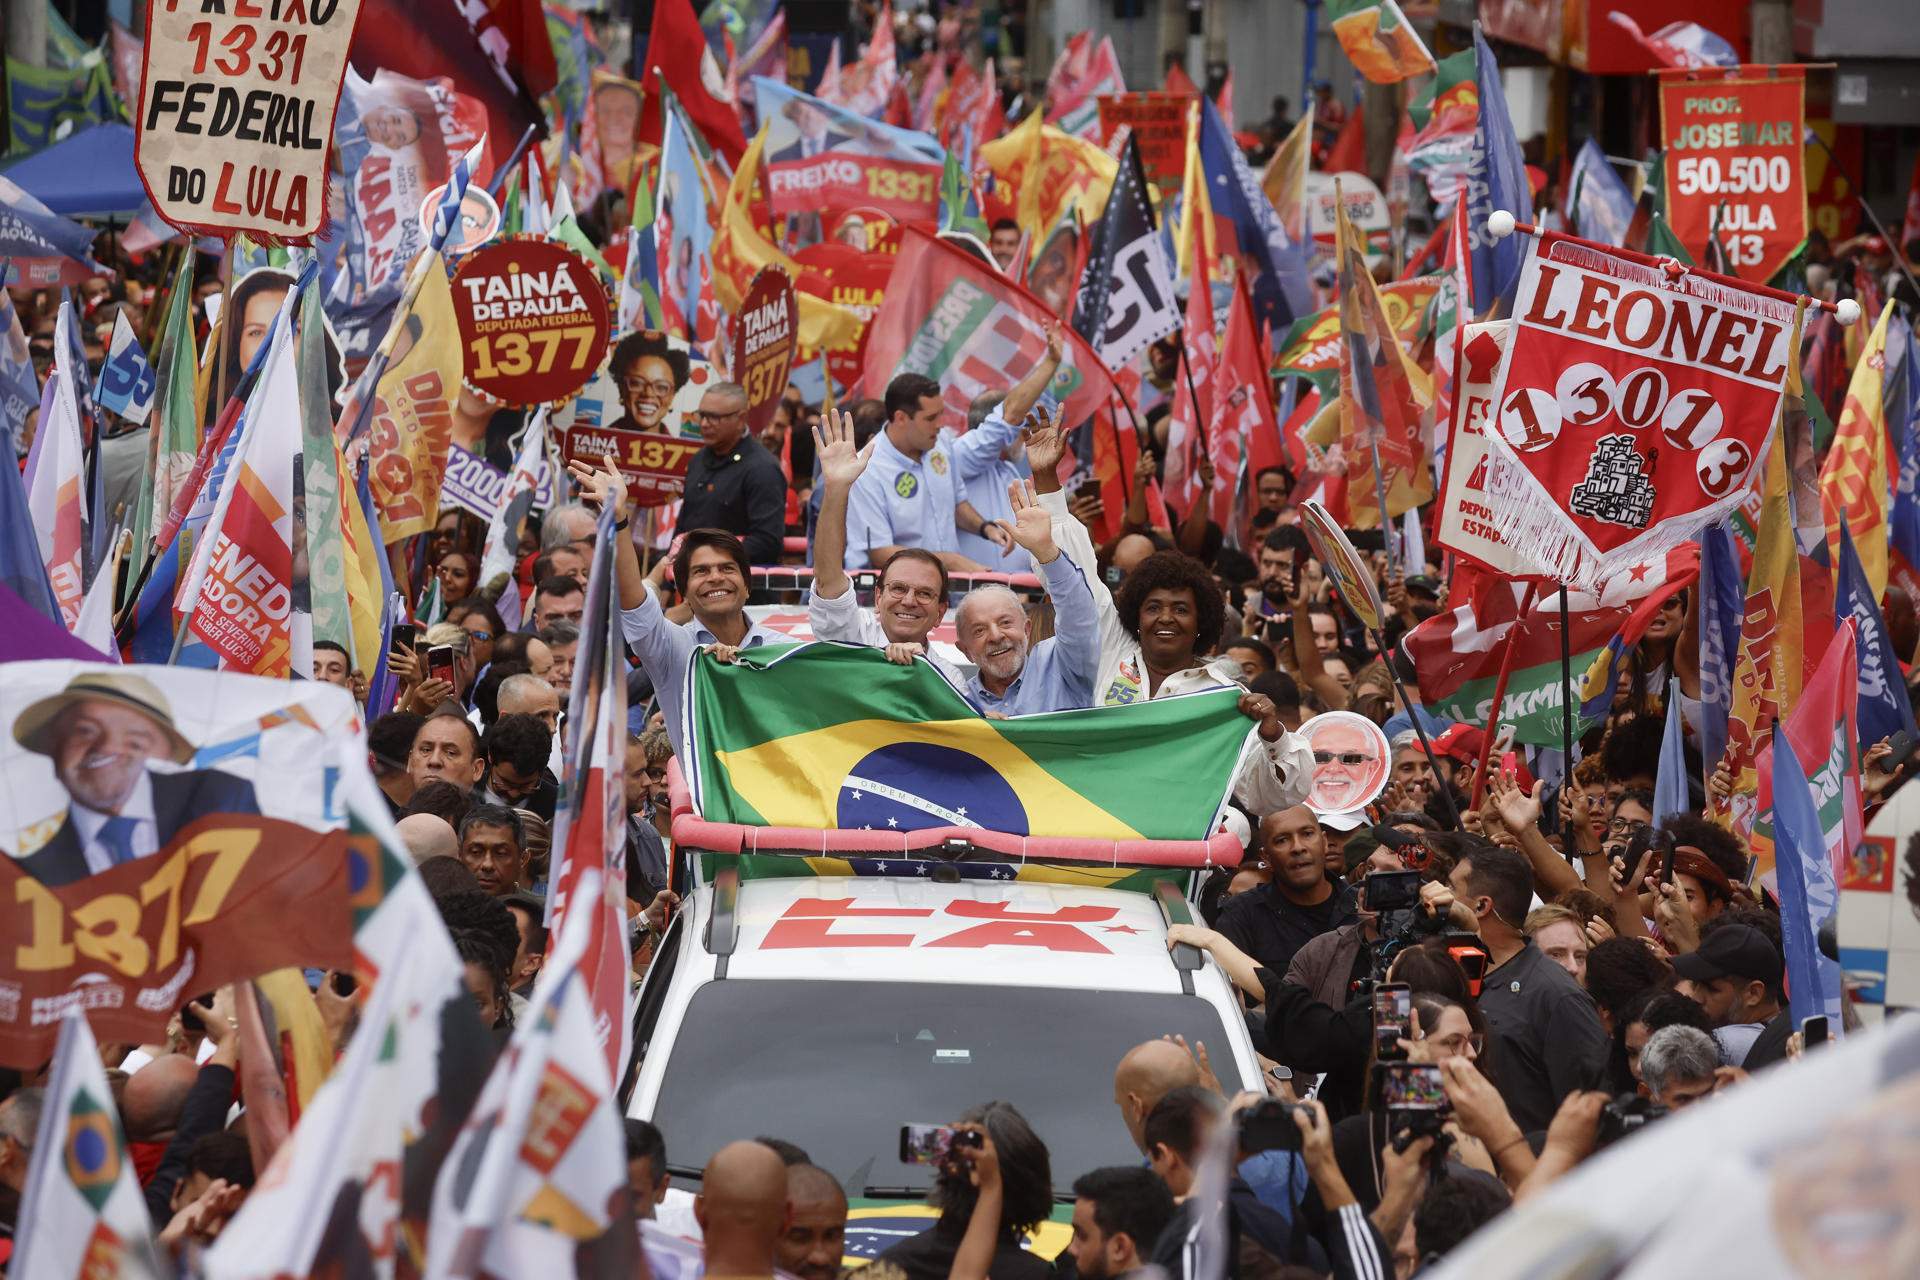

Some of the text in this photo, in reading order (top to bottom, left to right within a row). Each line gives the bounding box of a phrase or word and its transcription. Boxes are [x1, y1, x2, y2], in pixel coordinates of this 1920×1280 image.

[187, 22, 307, 85] 1331
[146, 80, 322, 150] FEDERAL
[1684, 97, 1742, 114] PROF.
[1673, 121, 1794, 149] JOSEMAR
[168, 161, 308, 227] DO LULA
[770, 160, 935, 202] FREIXO 1331
[1677, 156, 1791, 195] 50.500
[1709, 204, 1777, 231] LULA
[1725, 234, 1765, 266] 13
[462, 262, 578, 303] TAINÁ
[473, 294, 588, 321] DE PAULA
[476, 312, 595, 332] DEPUTADA FEDERAL
[743, 289, 789, 338] TAINÁ
[1523, 264, 1787, 385] LEONEL
[470, 326, 597, 379] 1377
[207, 531, 293, 633] ENED
[199, 574, 273, 645] ADORA
[221, 632, 254, 665] LUCAS
[860, 780, 906, 800] ORDEM
